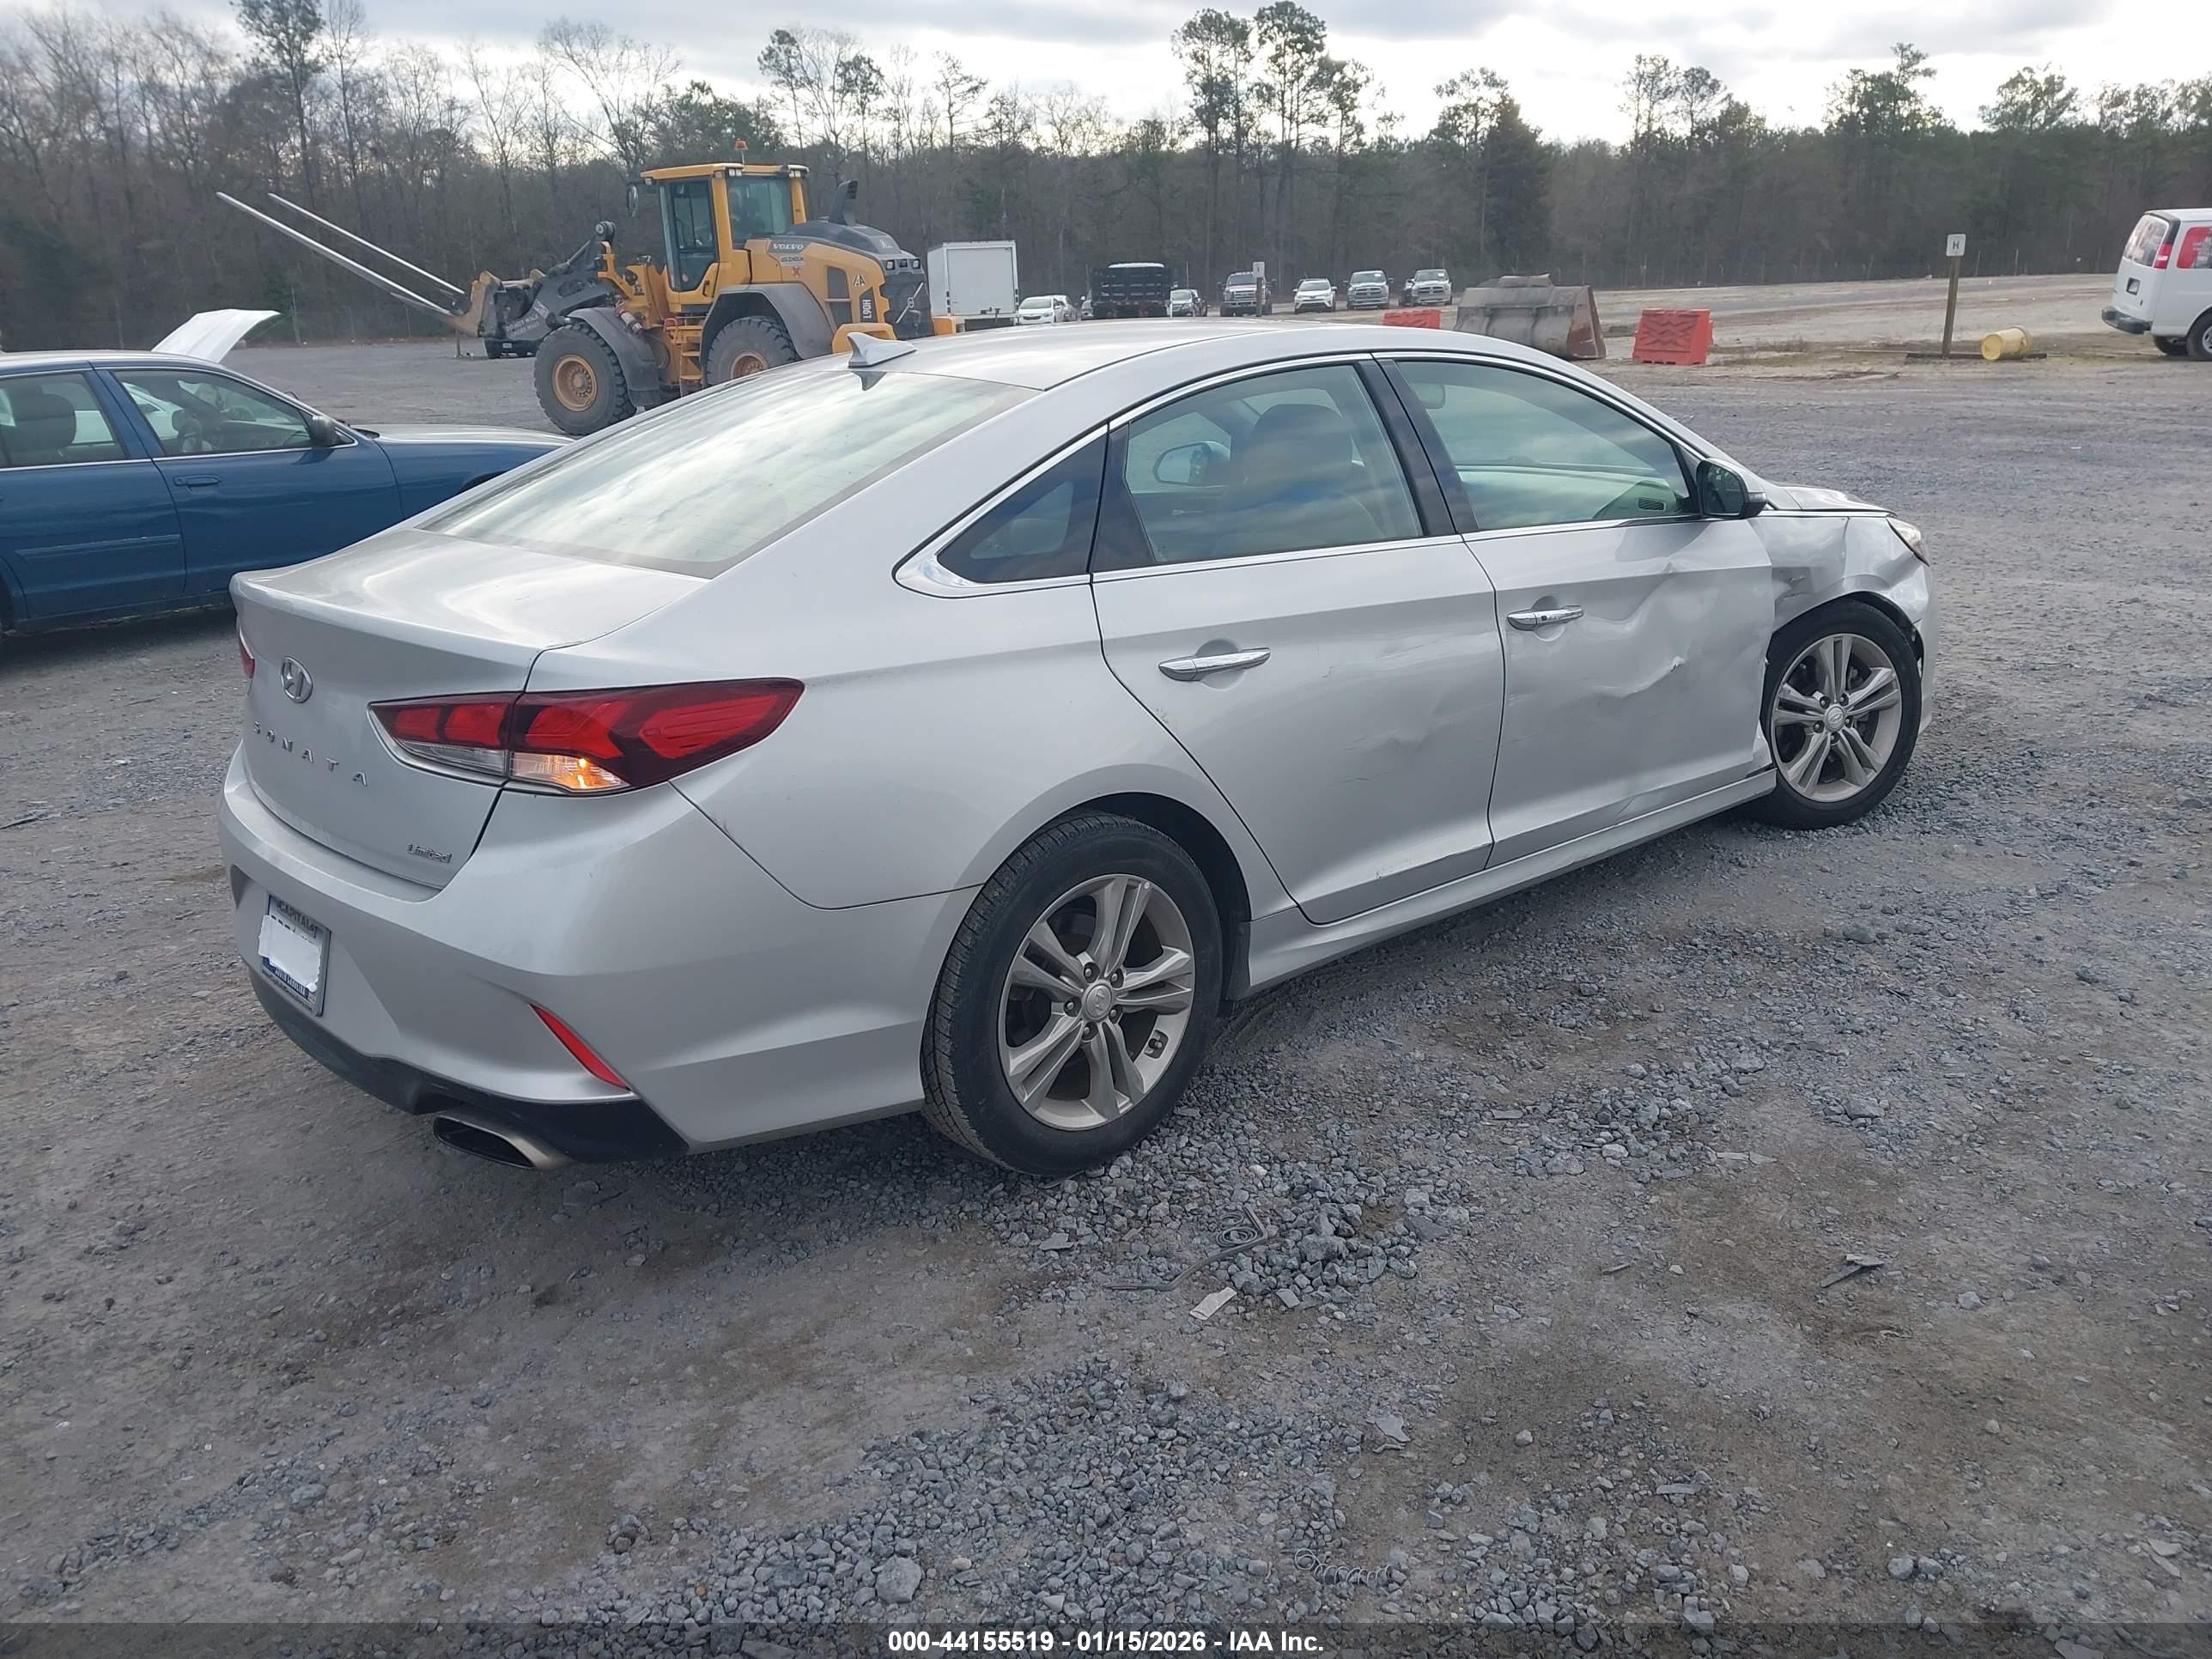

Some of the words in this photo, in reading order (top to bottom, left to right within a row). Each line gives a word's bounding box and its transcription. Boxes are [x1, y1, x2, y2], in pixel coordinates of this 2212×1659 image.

[862, 299, 872, 319] L90H
[253, 720, 368, 787] SONATA
[407, 843, 453, 864] Limited
